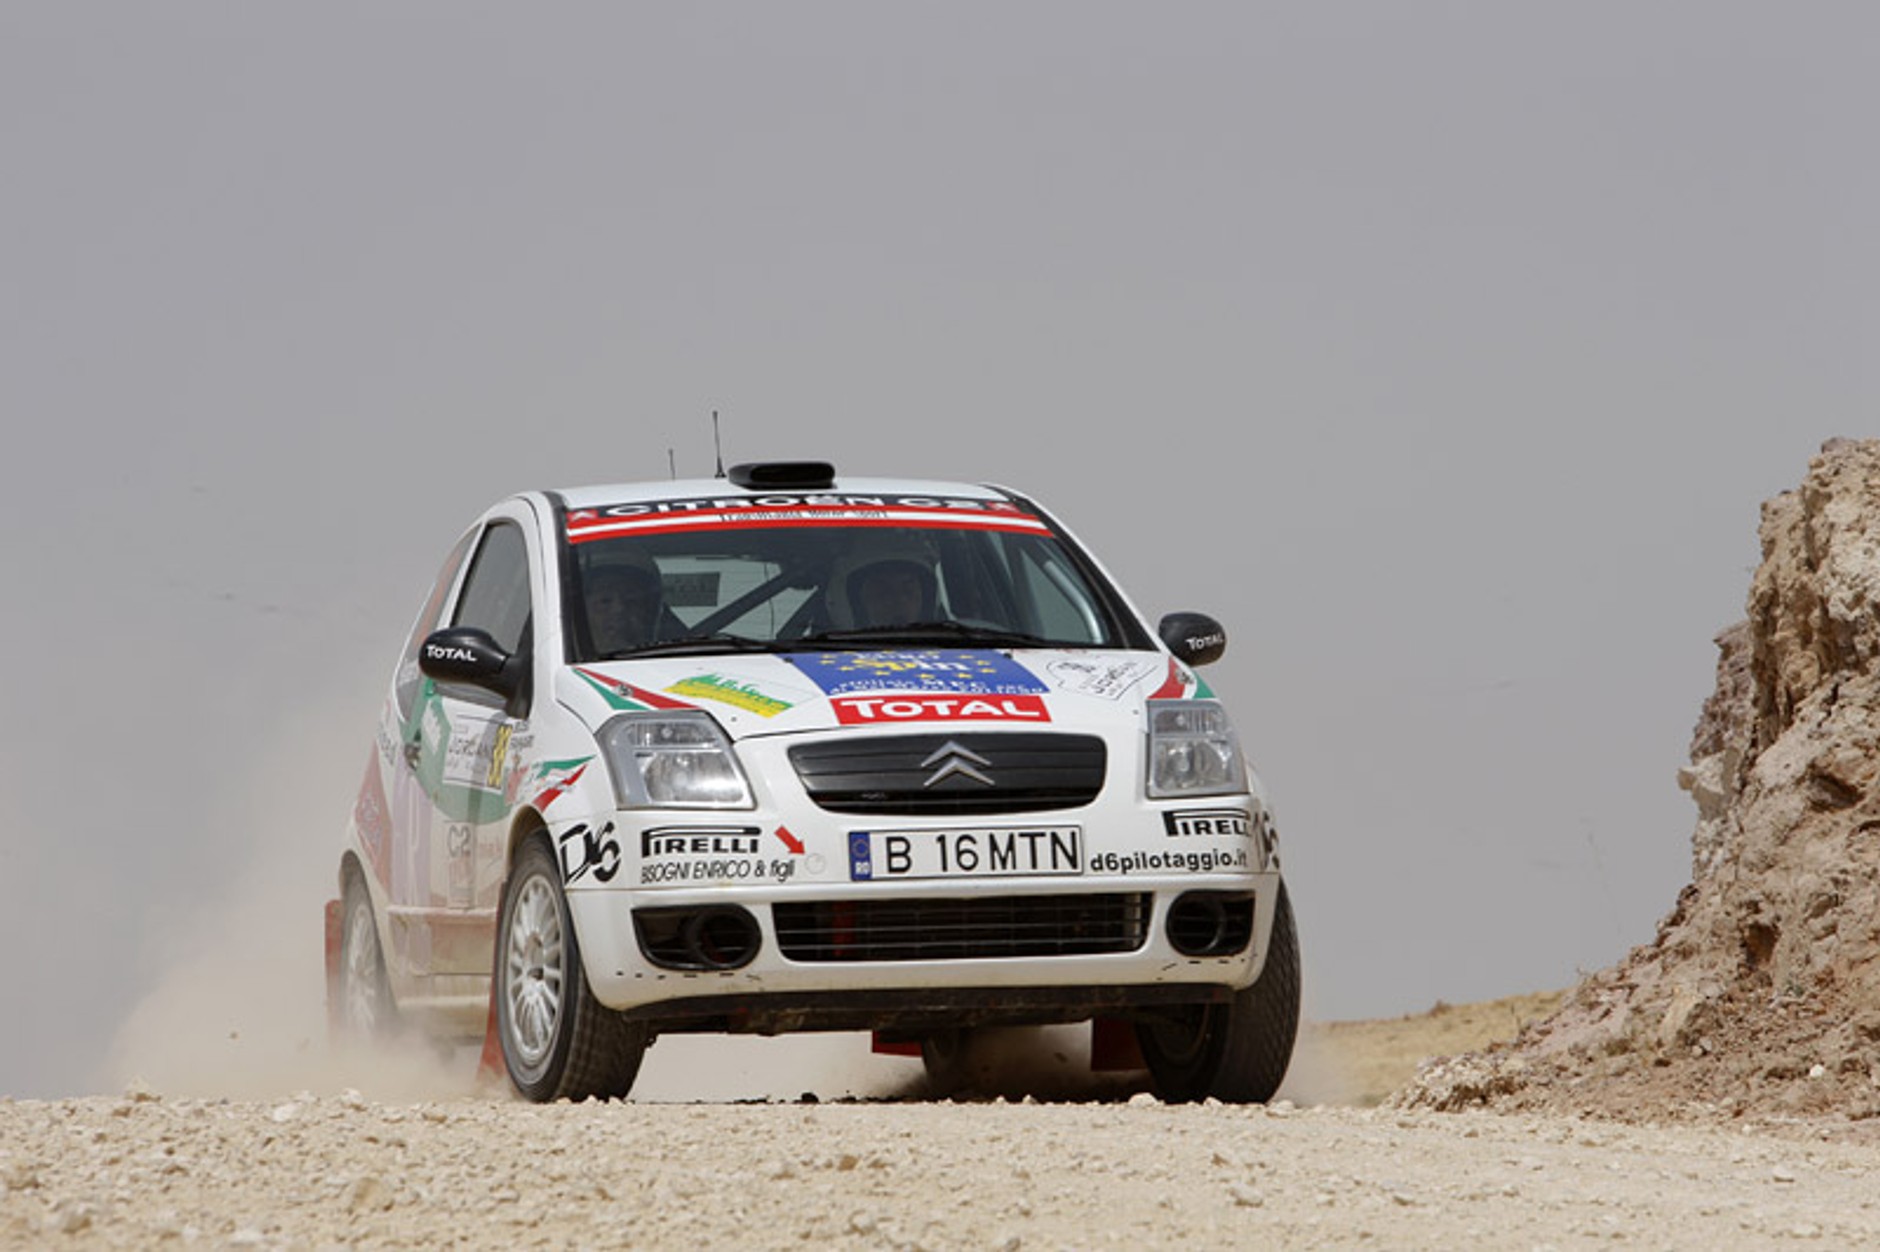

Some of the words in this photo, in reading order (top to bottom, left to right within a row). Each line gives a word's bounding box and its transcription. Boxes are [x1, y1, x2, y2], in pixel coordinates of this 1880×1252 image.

[1185, 633, 1223, 651] TOTAL
[427, 645, 477, 662] TOTAL
[841, 699, 1041, 719] TOTAL
[641, 824, 762, 858] PIRELLI
[885, 836, 912, 873] B
[936, 834, 979, 871] 16
[989, 831, 1078, 870] MTN
[692, 859, 750, 882] ENRICO
[754, 859, 766, 877] &
